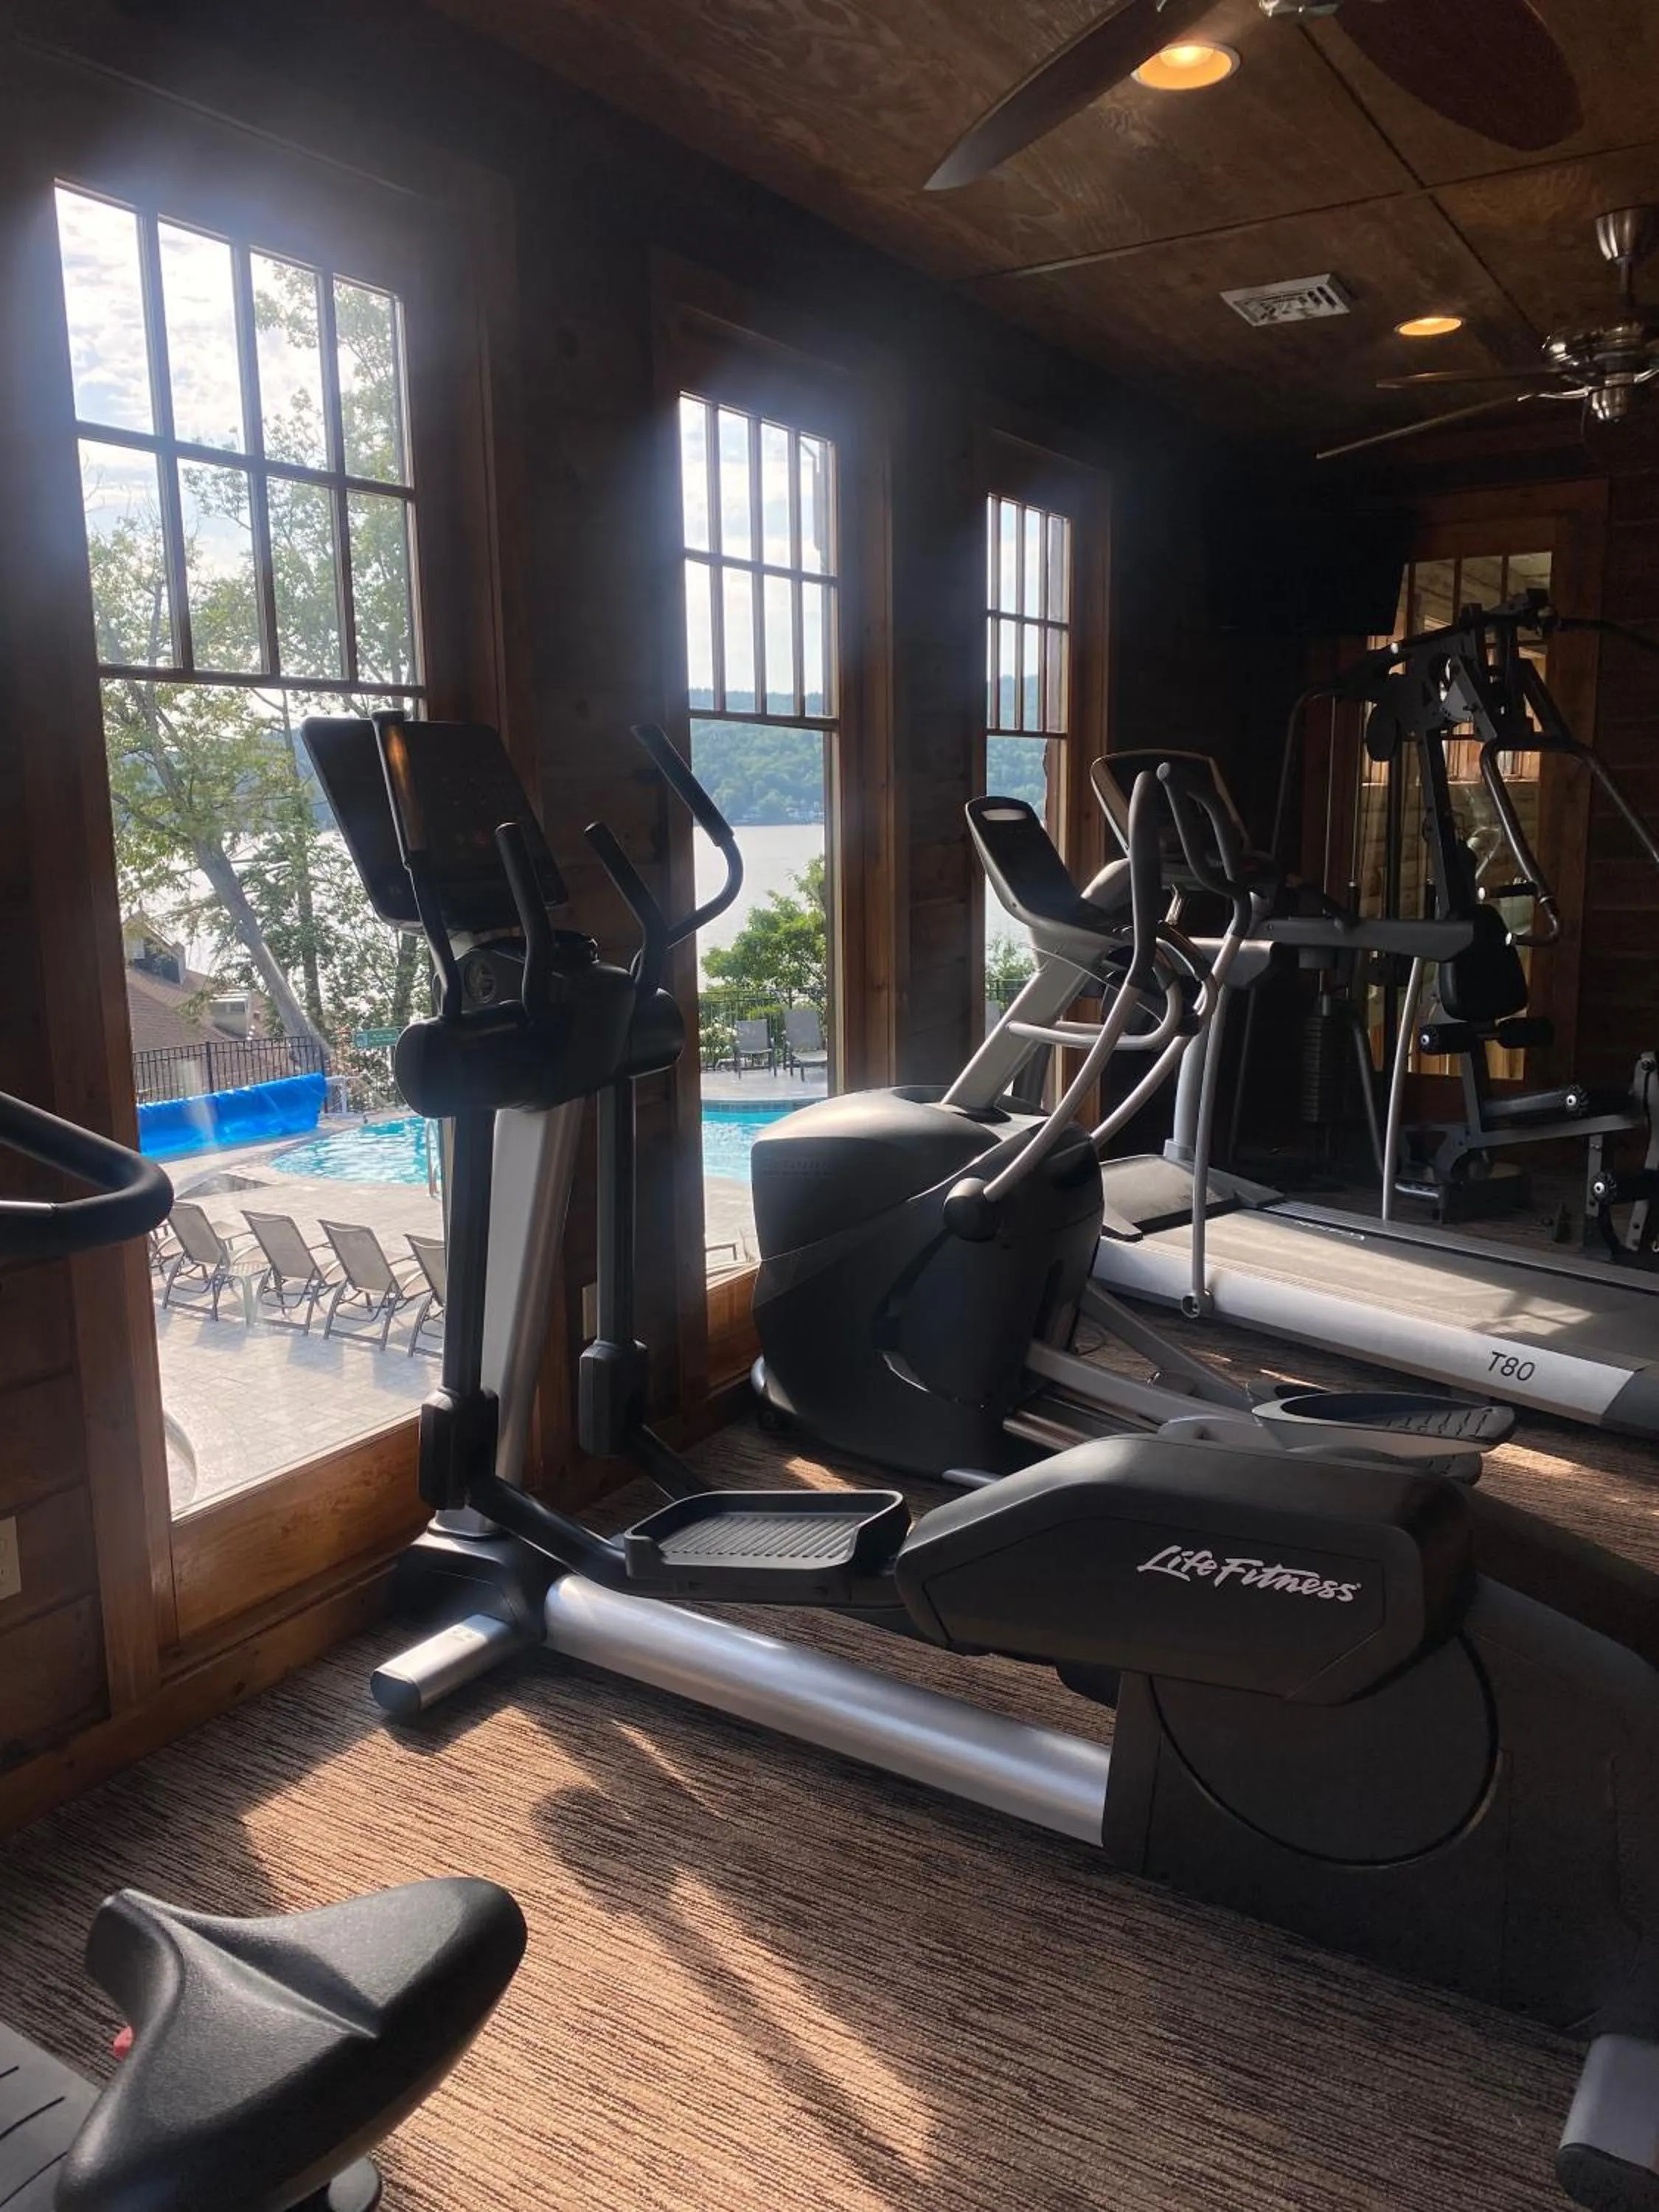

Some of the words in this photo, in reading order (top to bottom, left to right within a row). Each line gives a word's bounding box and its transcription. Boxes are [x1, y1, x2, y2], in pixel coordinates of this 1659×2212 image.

[1488, 1351, 1535, 1381] T80
[1136, 1545, 1217, 1582] Life
[1214, 1557, 1358, 1602] Fitness
